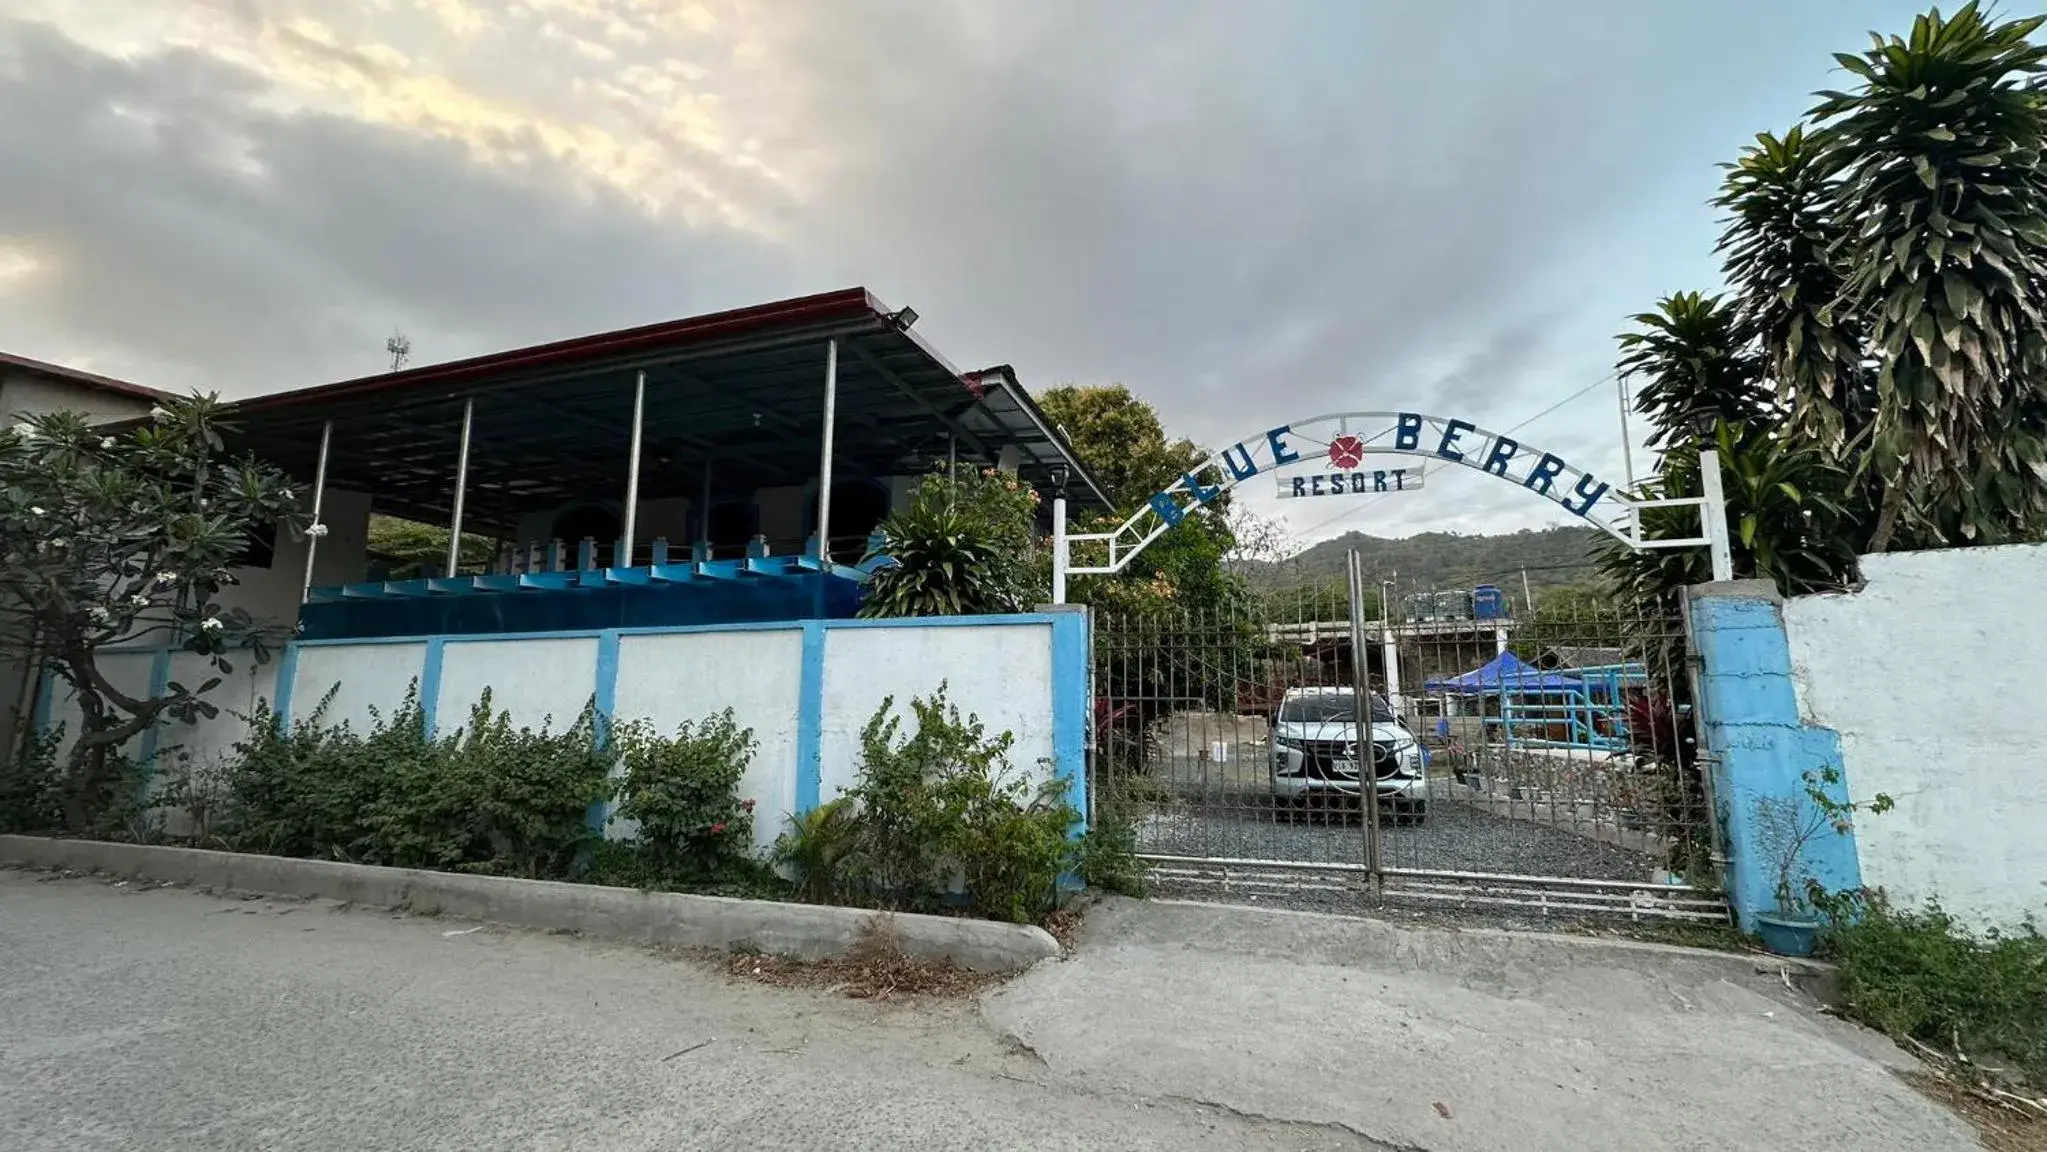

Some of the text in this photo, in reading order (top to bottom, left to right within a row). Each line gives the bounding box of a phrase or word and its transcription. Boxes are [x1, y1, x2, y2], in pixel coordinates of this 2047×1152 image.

[1151, 413, 1609, 527] BLUE BERRY
[1293, 469, 1406, 497] RESORT
